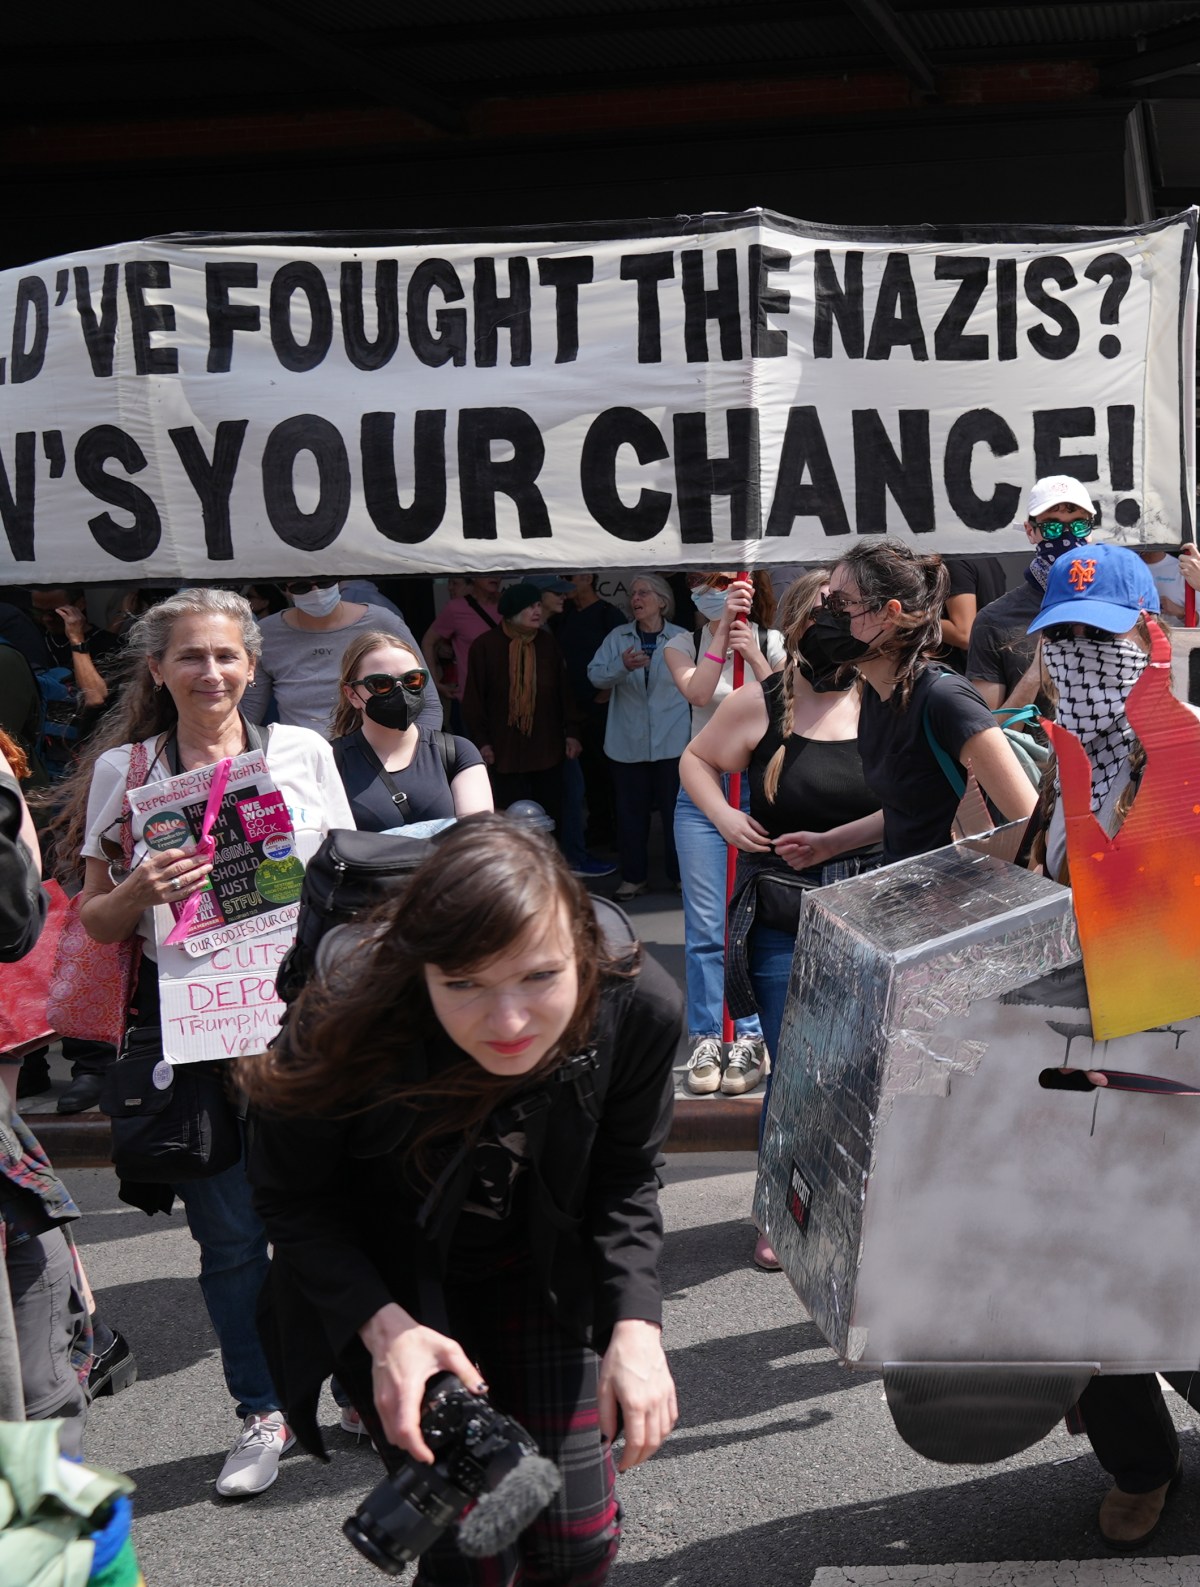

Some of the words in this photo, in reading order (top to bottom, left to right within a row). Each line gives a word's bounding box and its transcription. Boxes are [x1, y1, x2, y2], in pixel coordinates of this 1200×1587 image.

[205, 255, 594, 373] FOUGHT
[619, 243, 792, 364] THE
[813, 249, 1133, 362] NAZIS?
[168, 406, 553, 561] YOUR
[581, 403, 1142, 544] CHANCE!
[312, 648, 333, 656] JOY
[171, 770, 216, 790] PROTEC
[136, 781, 212, 814] REPRODUCTIV
[221, 793, 238, 809] HO
[240, 801, 261, 813] WE
[242, 803, 284, 822] WON'T
[146, 818, 180, 835] Vote
[194, 815, 228, 837] HTH
[246, 818, 264, 829] GO
[249, 822, 281, 838] BACK.
[230, 829, 239, 842] A
[212, 841, 254, 865] AGINA
[211, 856, 260, 882] SHOULD
[219, 877, 248, 898] JUST
[190, 937, 213, 953] OUR
[256, 913, 281, 931] OUR
[188, 977, 281, 1011] DEPO
